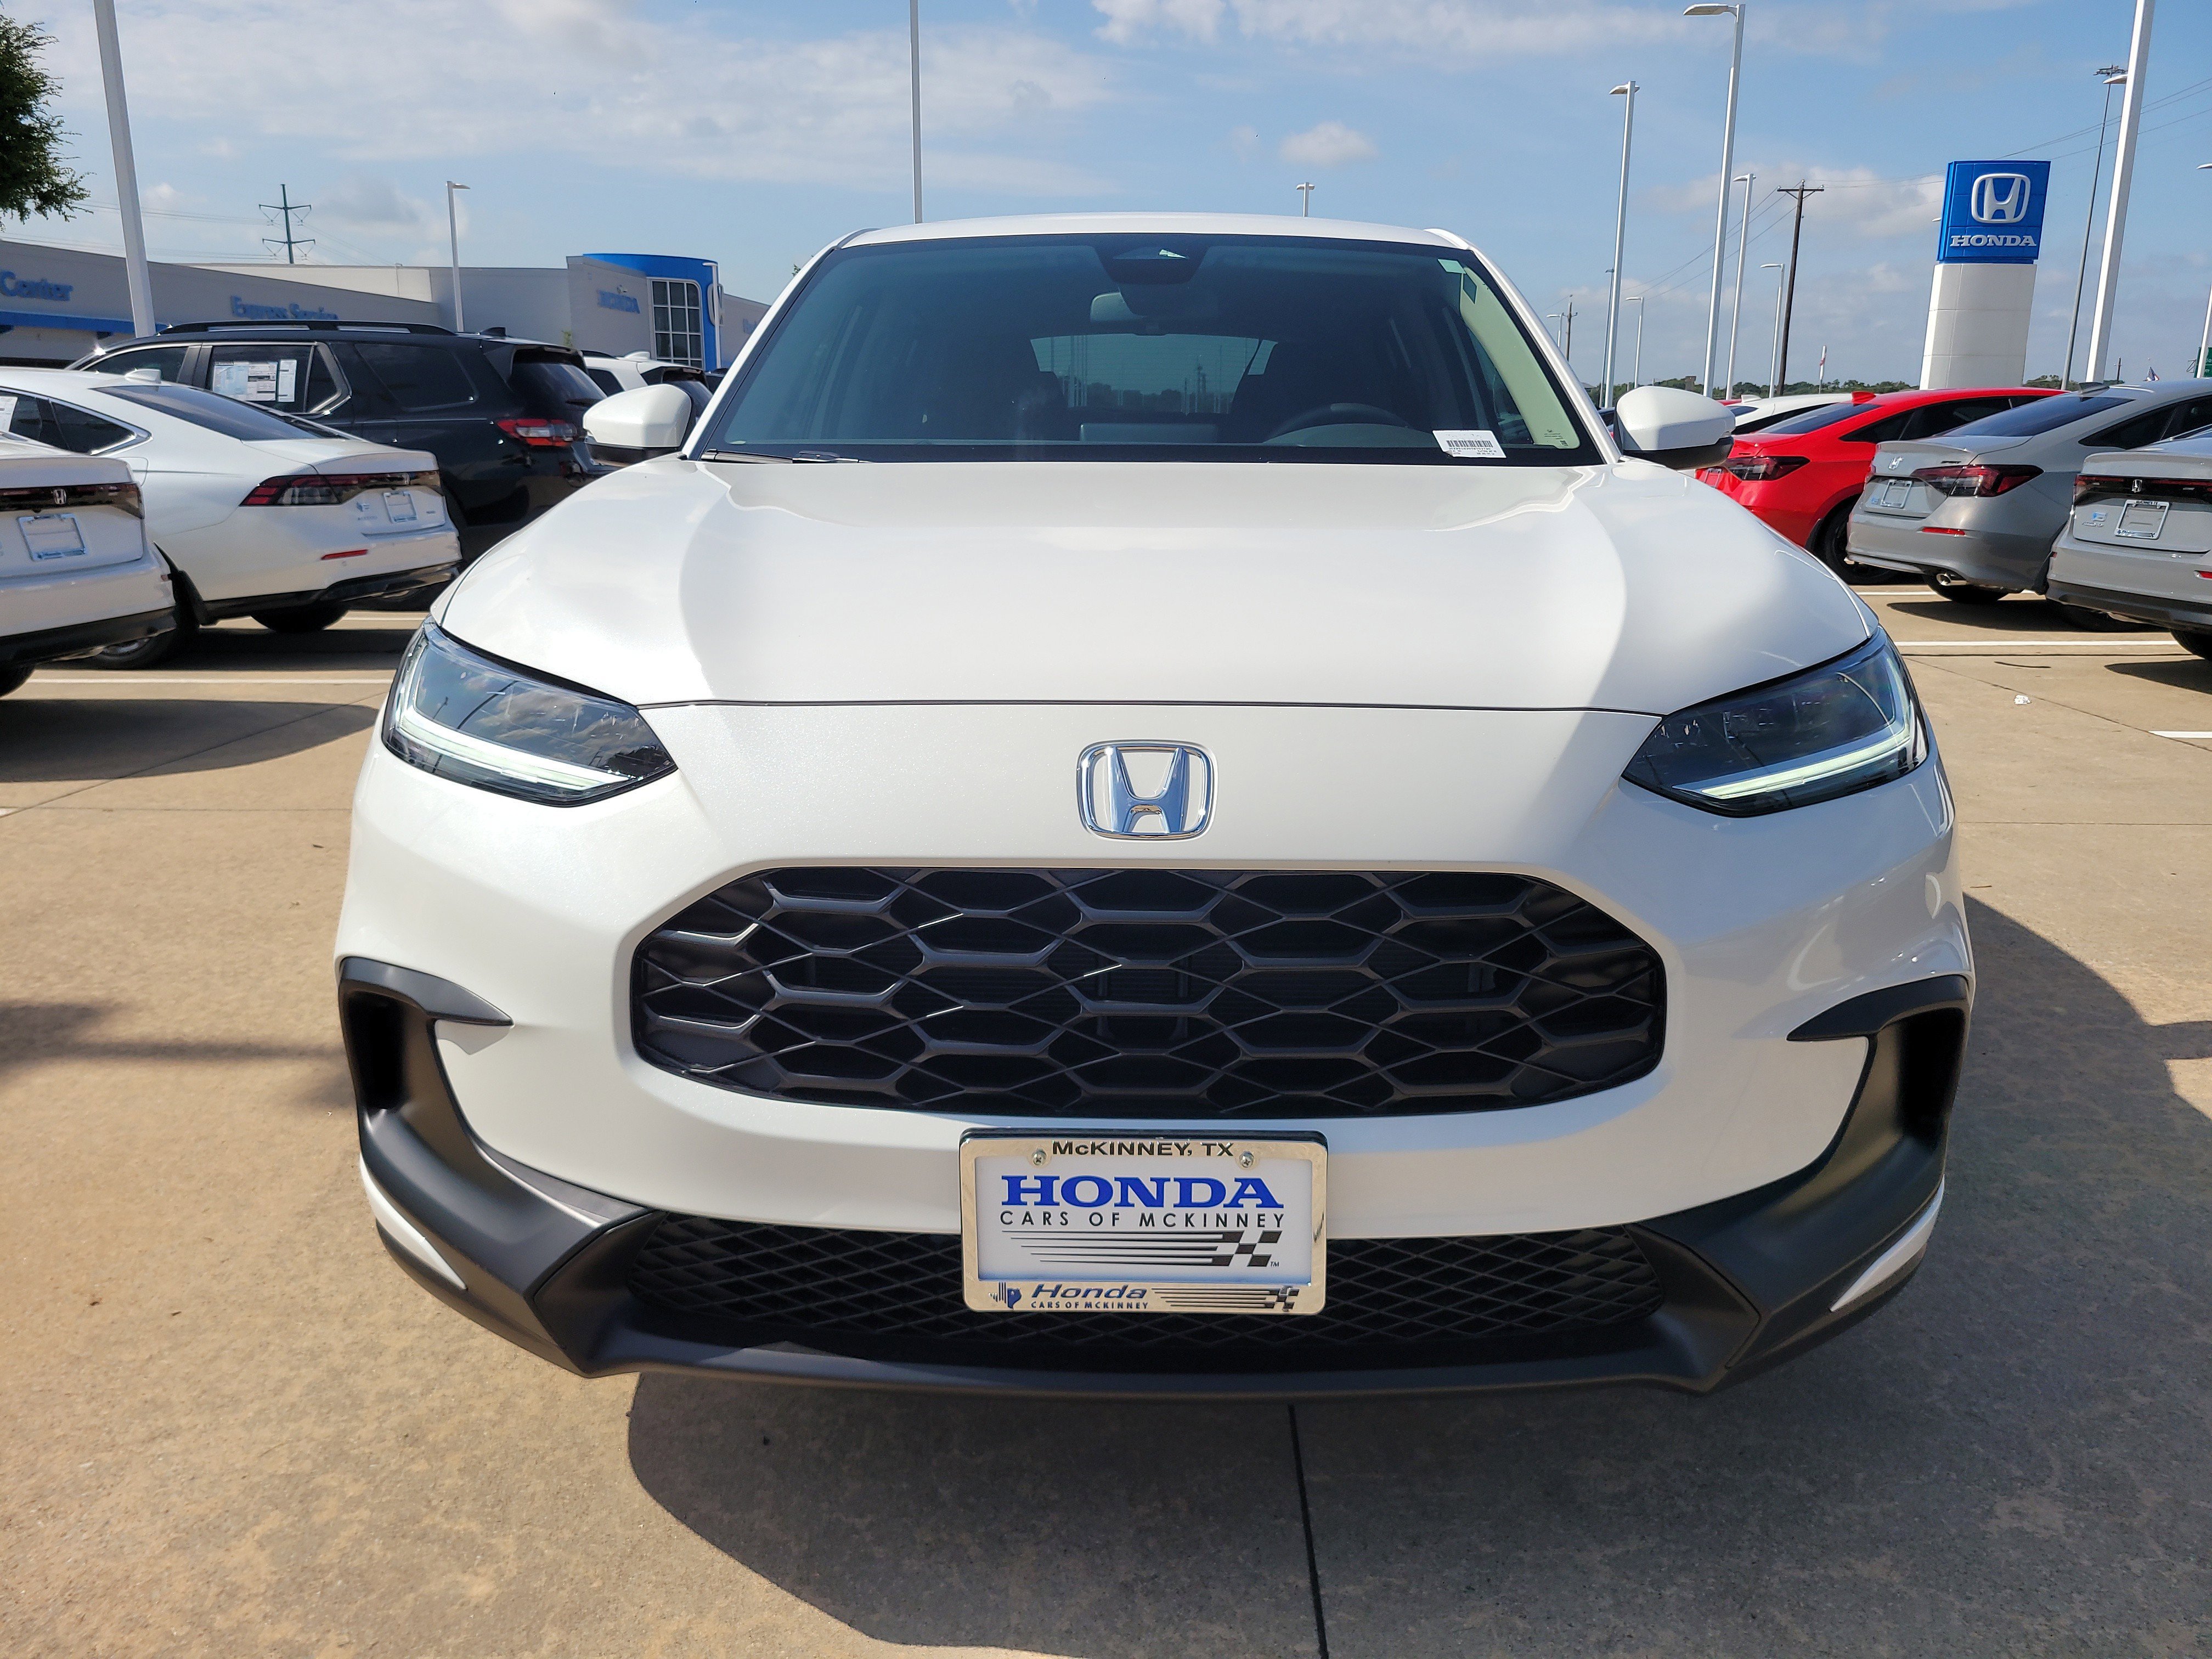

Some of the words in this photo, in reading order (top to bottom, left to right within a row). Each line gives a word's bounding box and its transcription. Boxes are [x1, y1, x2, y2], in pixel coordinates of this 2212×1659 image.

[1950, 234, 2037, 247] HONDA
[0, 270, 74, 302] Center
[1052, 1140, 1193, 1156] McKINNEY,
[1200, 1142, 1234, 1156] TX
[1001, 1175, 1284, 1208] HONDA
[1000, 1210, 1069, 1226] CARS
[1089, 1211, 1120, 1227] OF
[1139, 1212, 1284, 1228] MCKINNEY
[1031, 1283, 1147, 1299] Honda
[1031, 1301, 1060, 1309] CARS
[1084, 1301, 1149, 1310] MCKINNEY
